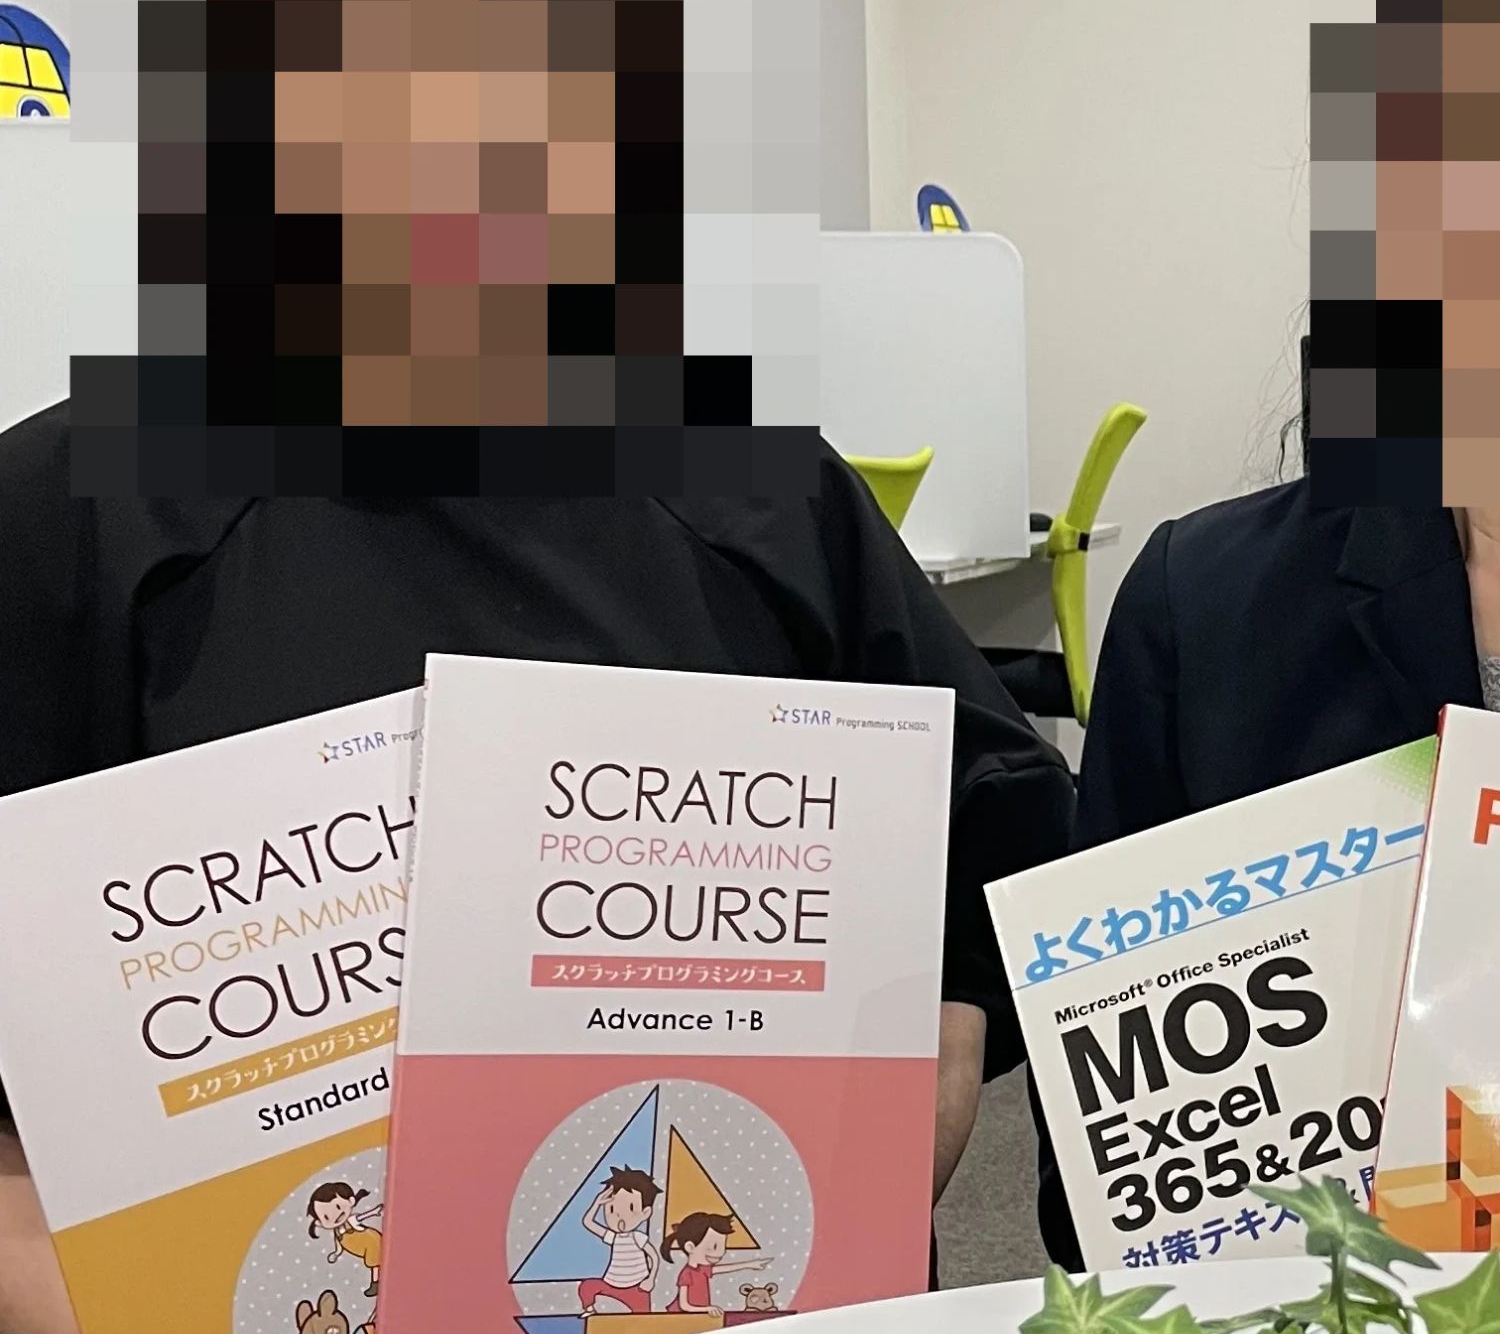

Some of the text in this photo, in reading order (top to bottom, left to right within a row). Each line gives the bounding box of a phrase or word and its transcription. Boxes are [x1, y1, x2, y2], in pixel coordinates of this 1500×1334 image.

[791, 708, 832, 725] STAR
[543, 760, 837, 831] SCRATCH
[102, 795, 417, 943] SCRATCH
[539, 832, 833, 873] PROGRAMMING
[118, 881, 408, 990] PROGRAMMIN
[536, 879, 831, 945] COURSE
[1025, 823, 1426, 984] よくわかるマスター
[551, 962, 806, 985] スクラッチプログラミングコース
[1156, 962, 1214, 989] Office
[1217, 927, 1311, 967] Specialist
[141, 926, 407, 1060] COURS
[586, 1007, 764, 1031] Advance 1-B
[1060, 955, 1328, 1117] MOS
[258, 1066, 390, 1132] Standard
[1085, 1063, 1283, 1176] Excel
